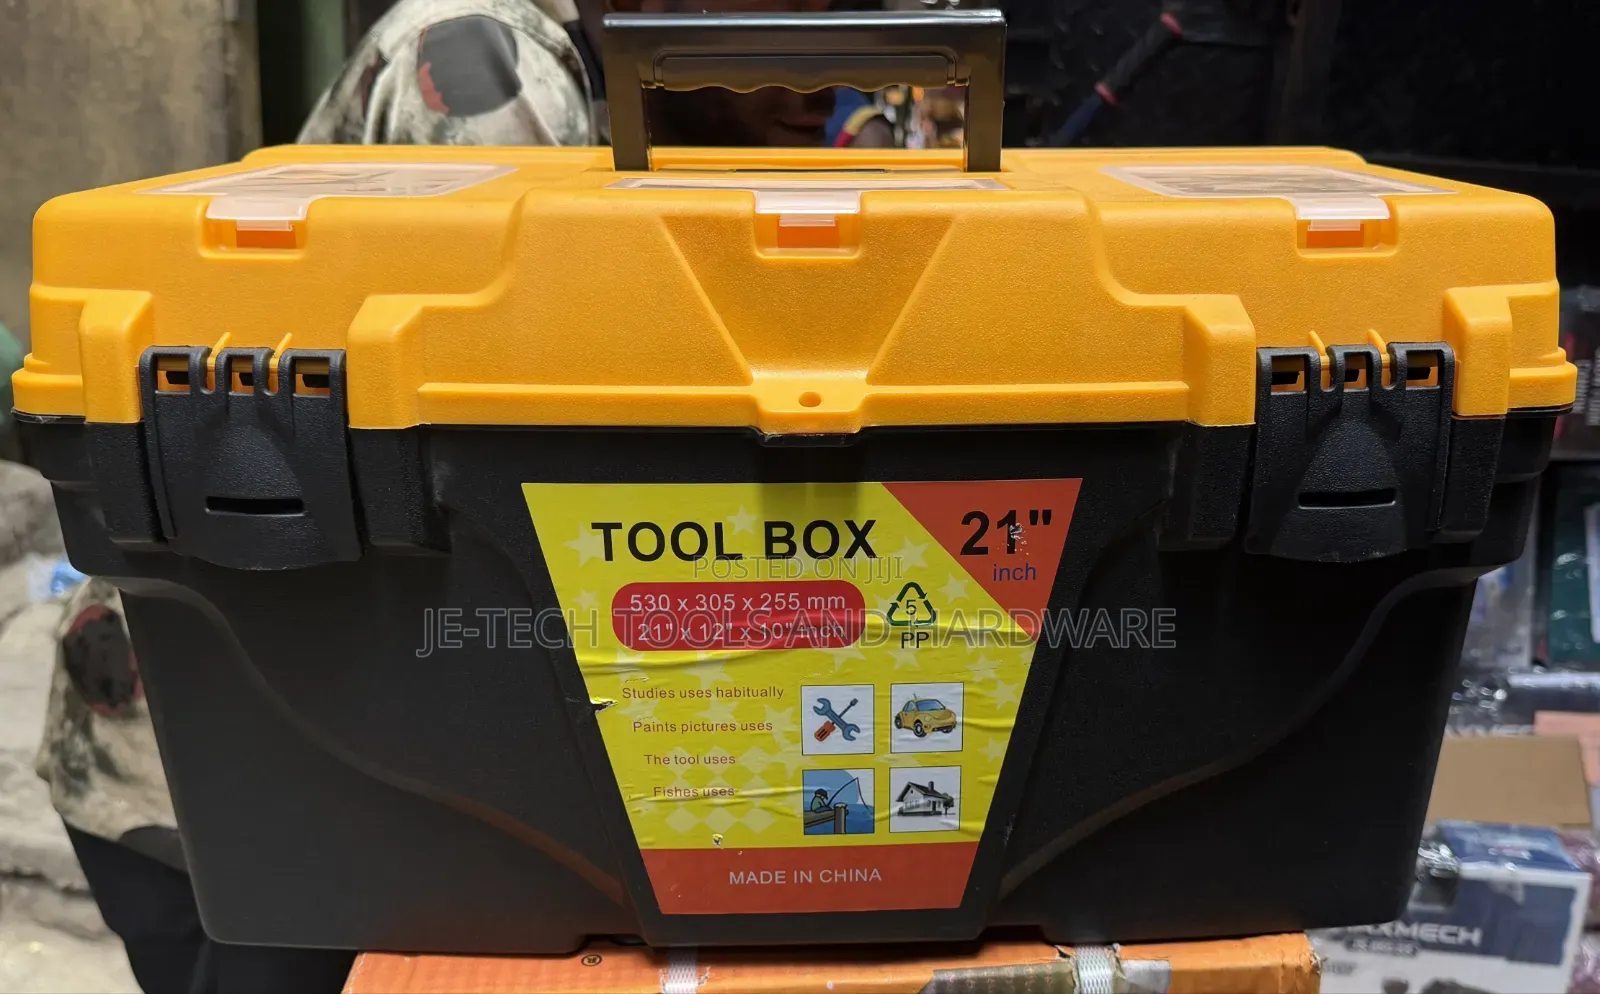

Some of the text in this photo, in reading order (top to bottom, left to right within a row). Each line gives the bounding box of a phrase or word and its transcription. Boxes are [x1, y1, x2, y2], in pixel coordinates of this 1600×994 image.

[591, 519, 877, 562] TOOL BOX
[960, 509, 1052, 556] 21"
[993, 563, 1036, 582] inch
[630, 592, 846, 612] 530 x 305 x 255 mm
[905, 599, 917, 615] 5
[638, 623, 673, 641] 21"
[799, 622, 846, 639] inch
[901, 631, 930, 649] PP
[622, 685, 785, 702] Studies uses habitually
[633, 720, 773, 736] Paints pictures uses
[644, 753, 736, 766] The tool uses
[653, 785, 735, 798] Fishes uses
[729, 868, 882, 886] MADE IN CHINA
